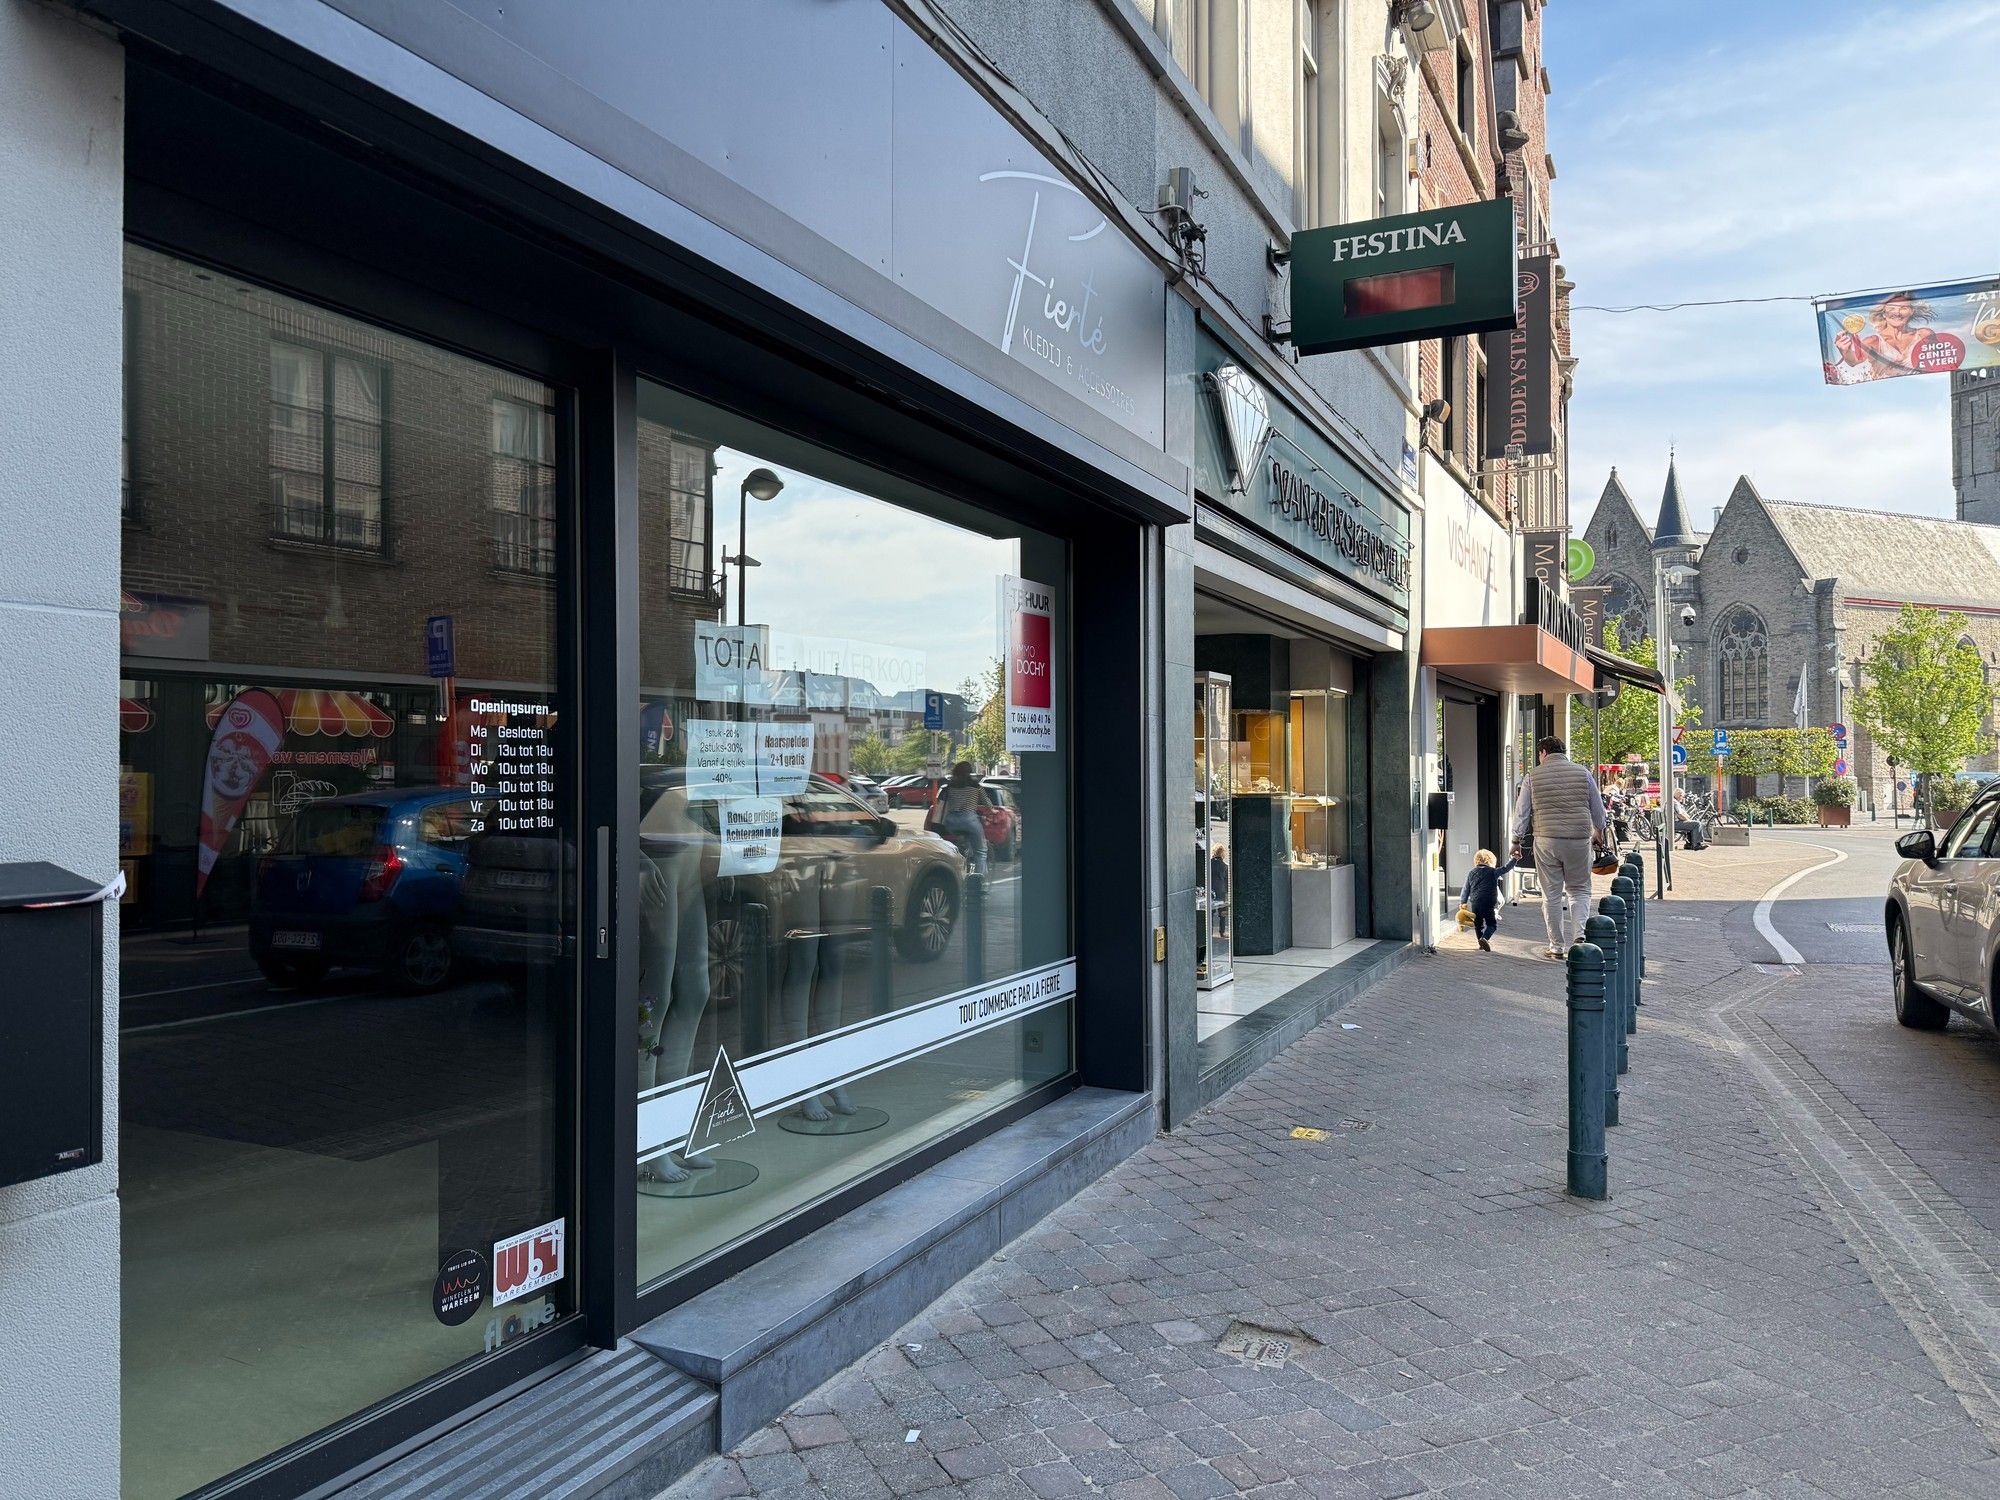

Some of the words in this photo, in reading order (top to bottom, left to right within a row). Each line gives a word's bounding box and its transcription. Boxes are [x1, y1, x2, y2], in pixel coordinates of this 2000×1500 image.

[1332, 219, 1467, 262] FESTINA
[1023, 325, 1061, 368] KLEDIJ
[1066, 355, 1073, 375] &
[1921, 341, 1954, 351] SHOP,
[1919, 348, 1957, 360] GENIET
[1928, 356, 1957, 367] VIER!
[1447, 515, 1498, 593] VISHANDEL
[1025, 592, 1050, 612] HUUR
[1016, 658, 1046, 677] DOCHY
[470, 699, 549, 716] Openingsuren
[1011, 713, 1016, 722] T
[470, 725, 487, 738] Ma
[498, 726, 543, 739] Gesloten
[1011, 725, 1051, 737] www.dochy.be
[470, 744, 482, 757] Di
[498, 745, 516, 757] 13u
[519, 745, 533, 757] tot
[536, 745, 553, 757] 18u
[697, 757, 719, 768] Vanaf
[720, 758, 725, 769] 4
[726, 757, 746, 767] stuks
[770, 754, 783, 766] 2+1
[784, 754, 805, 767] gratis
[470, 762, 488, 775] Wo
[498, 763, 516, 775] 10u
[519, 763, 534, 775] tot
[537, 763, 554, 775] 18u
[711, 773, 732, 783] -40%
[470, 782, 486, 794] Do
[498, 781, 516, 793] 10u
[519, 781, 534, 793] tot
[537, 781, 554, 792] 18u
[470, 801, 483, 813] Vr
[498, 800, 516, 812] 10u
[519, 799, 534, 811] tot
[537, 799, 554, 810] 18u
[470, 820, 485, 832] Za
[498, 818, 516, 830] 10u
[519, 818, 534, 829] tot
[537, 816, 554, 828] 18u
[727, 811, 753, 824] Ronde
[726, 828, 764, 842] Achteraan
[764, 827, 771, 838] in
[771, 826, 779, 837] de
[743, 844, 767, 857] winkel
[958, 1001, 978, 1025] TOUT
[979, 988, 1017, 1018] COMMENCE
[1018, 984, 1031, 1005] PAR
[1032, 981, 1041, 999] LA
[1041, 970, 1061, 997] FIERTÉ
[496, 1271, 559, 1302] WAREGEMBON
[441, 1291, 480, 1313] WAREGEM
[442, 1289, 472, 1305] WINKELEN
